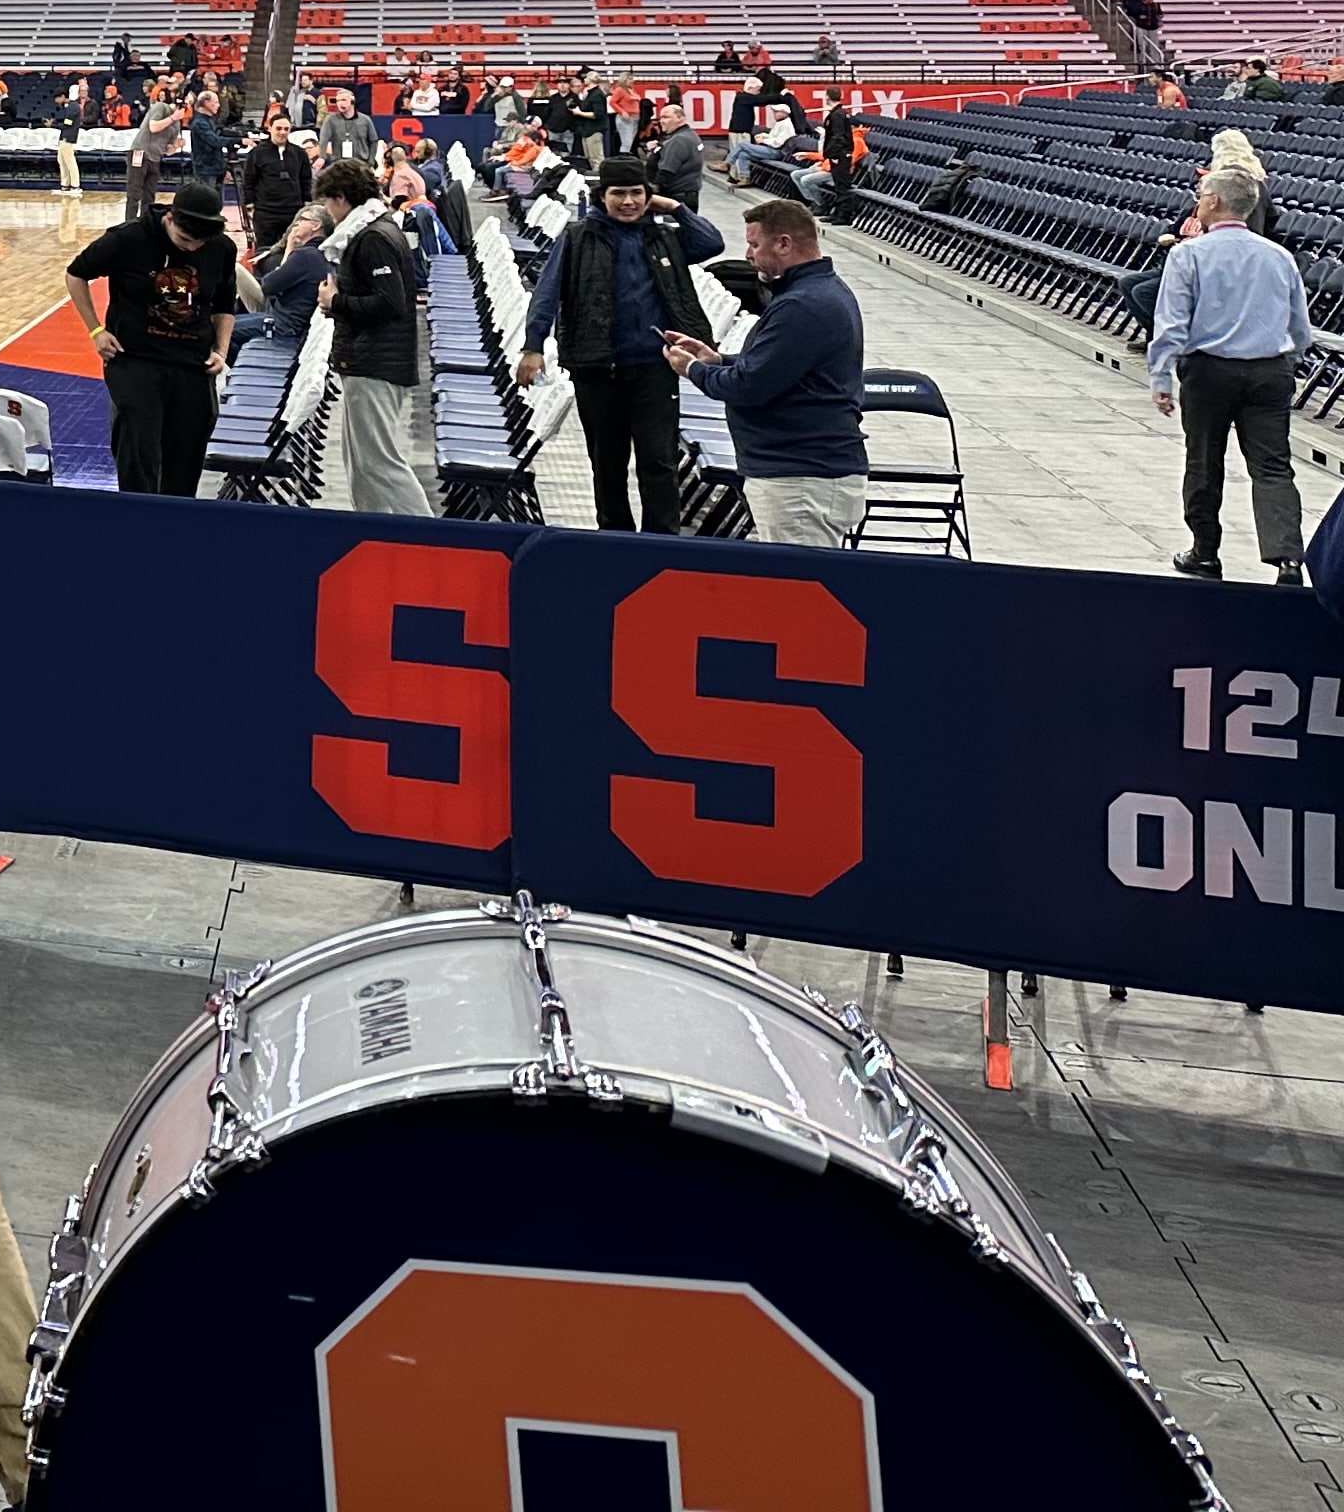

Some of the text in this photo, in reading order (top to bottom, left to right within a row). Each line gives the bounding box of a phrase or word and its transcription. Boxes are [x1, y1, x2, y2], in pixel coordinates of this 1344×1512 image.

[312, 540, 868, 898] S S
[358, 992, 413, 1066] YAMAHA
